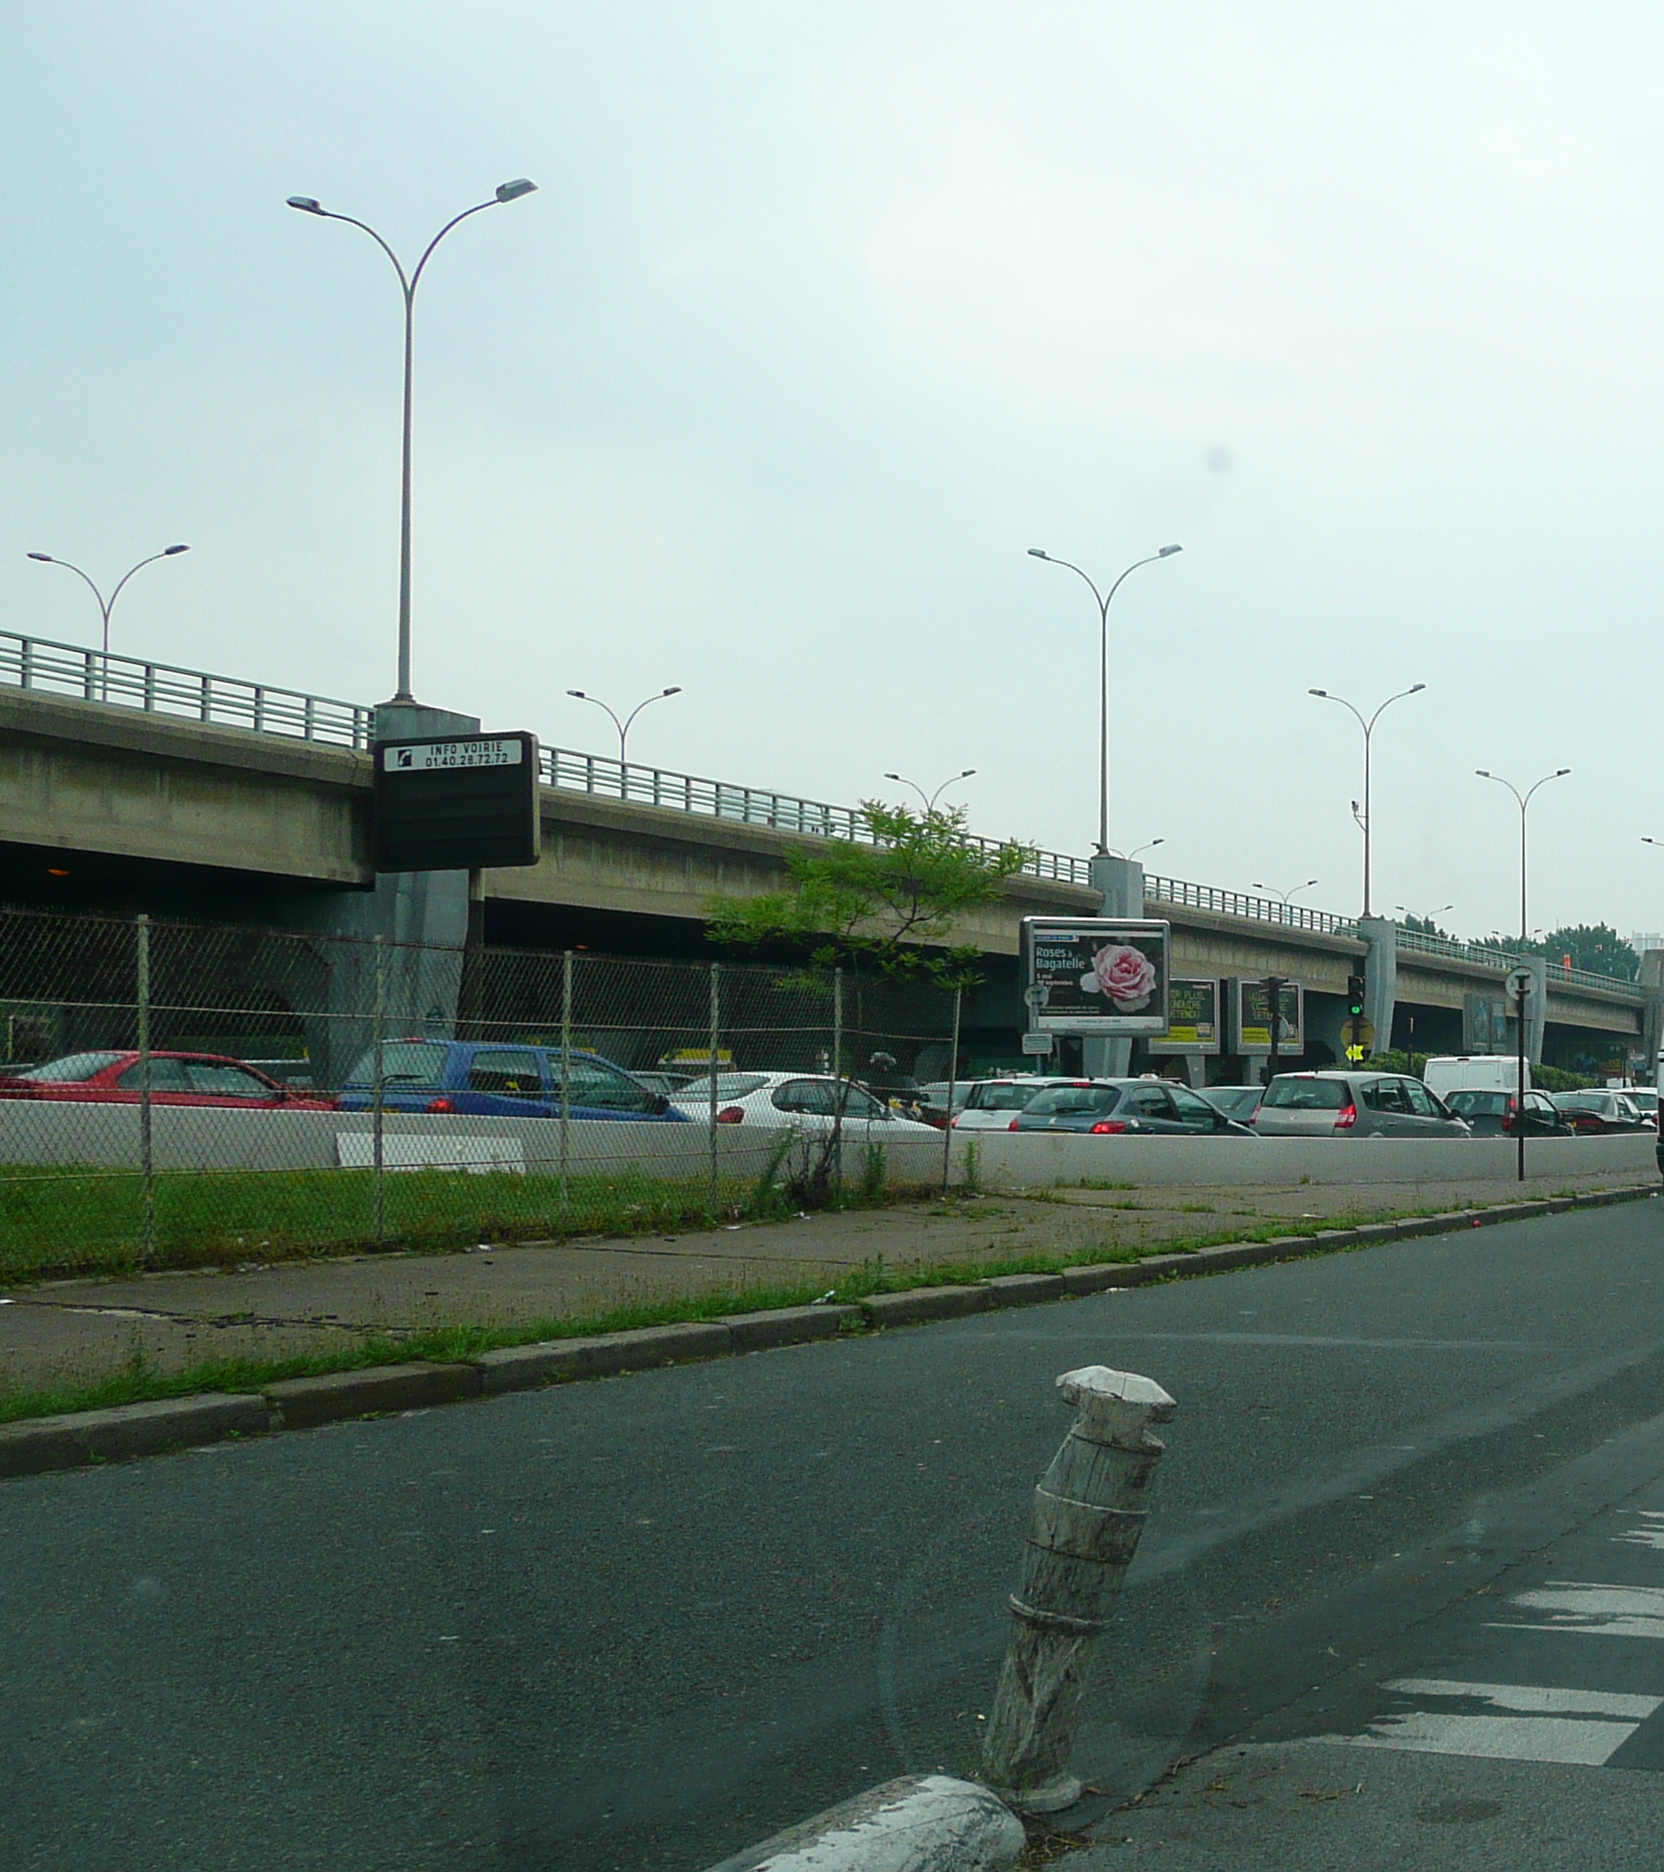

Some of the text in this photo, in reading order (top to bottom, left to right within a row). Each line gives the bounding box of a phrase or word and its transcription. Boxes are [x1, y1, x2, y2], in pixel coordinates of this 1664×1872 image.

[430, 742, 503, 756] INFO VOIRIE
[425, 753, 508, 767] 01.40.28.72.72
[1035, 946, 1067, 958] Roses
[1035, 957, 1086, 972] Bagatelle
